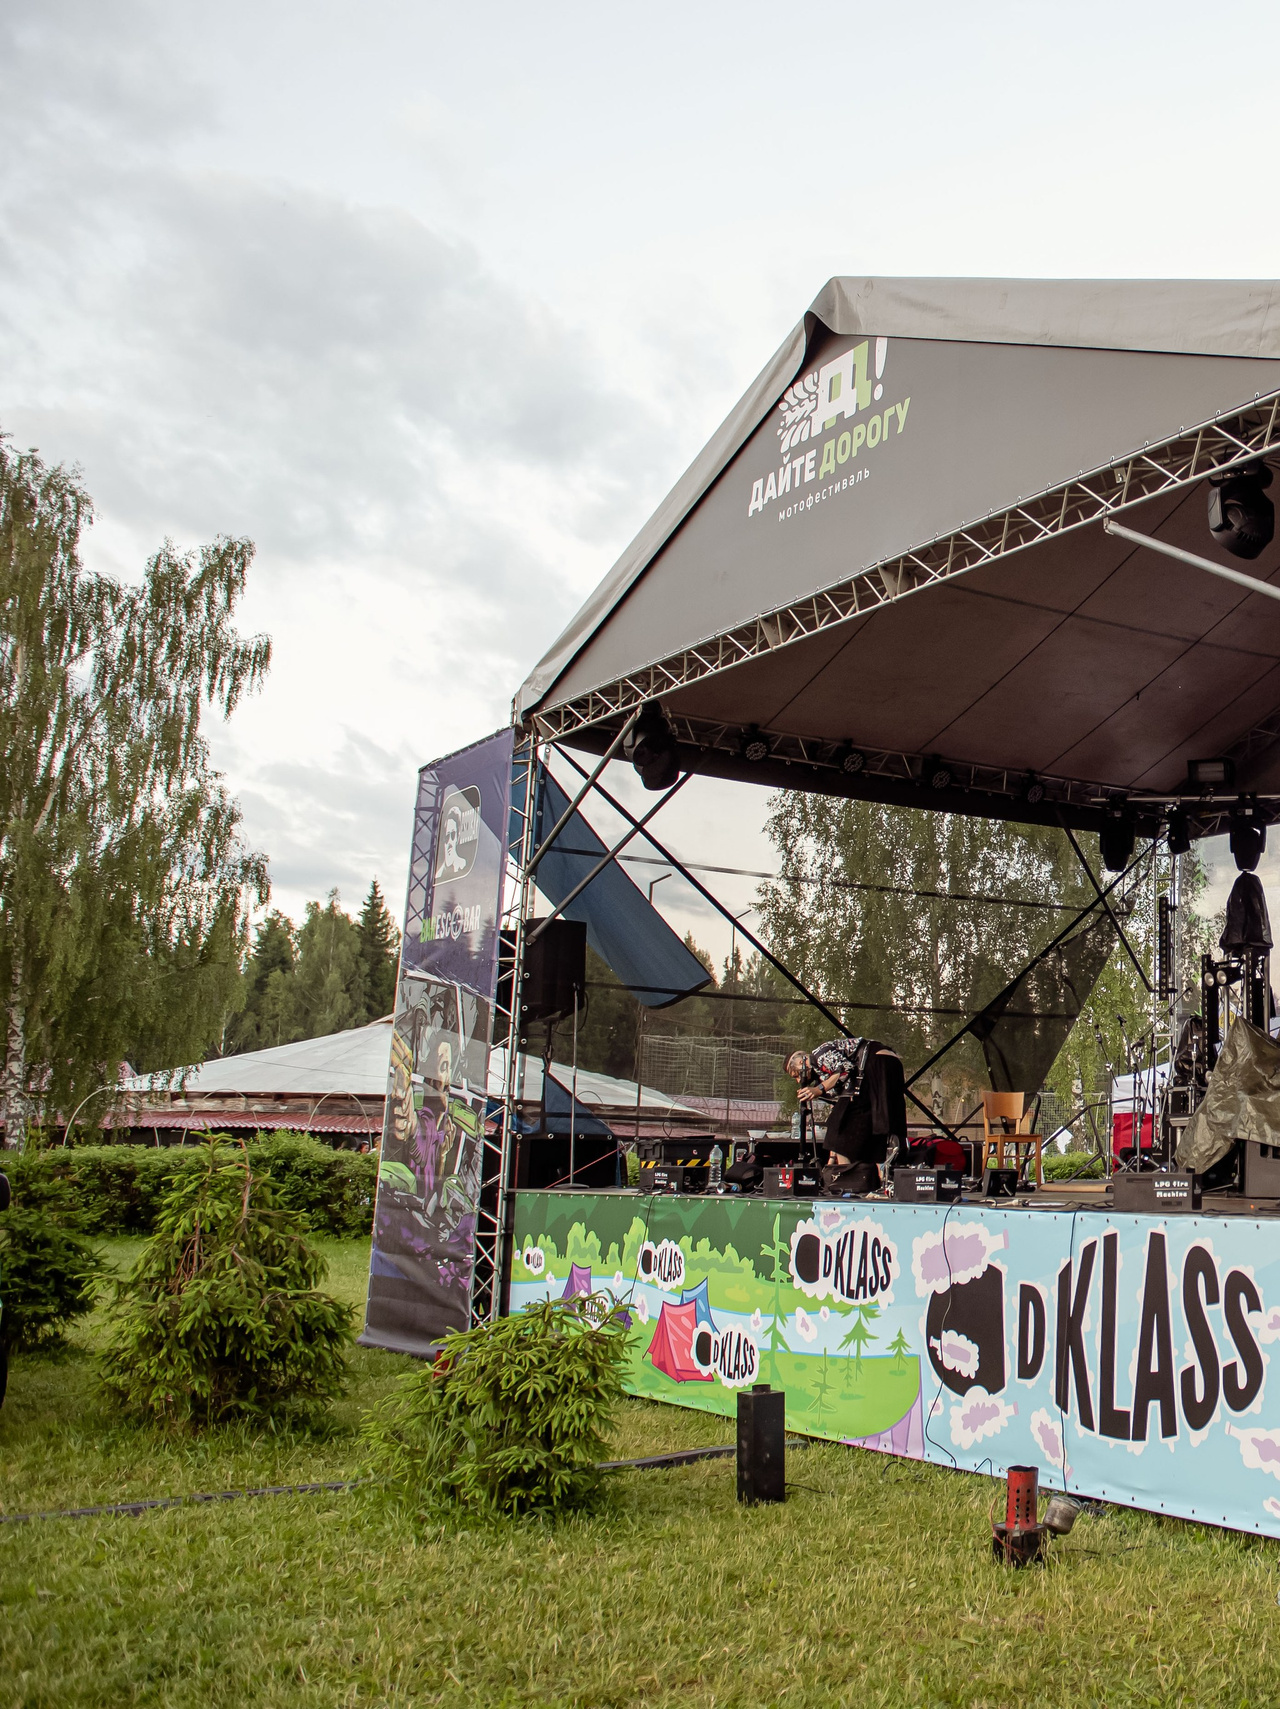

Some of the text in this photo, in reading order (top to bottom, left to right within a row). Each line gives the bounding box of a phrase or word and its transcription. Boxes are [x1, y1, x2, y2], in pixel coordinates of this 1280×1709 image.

[748, 397, 911, 517] ДАЙТЕ ДОРОГУ
[778, 467, 870, 522] мотофестиваль
